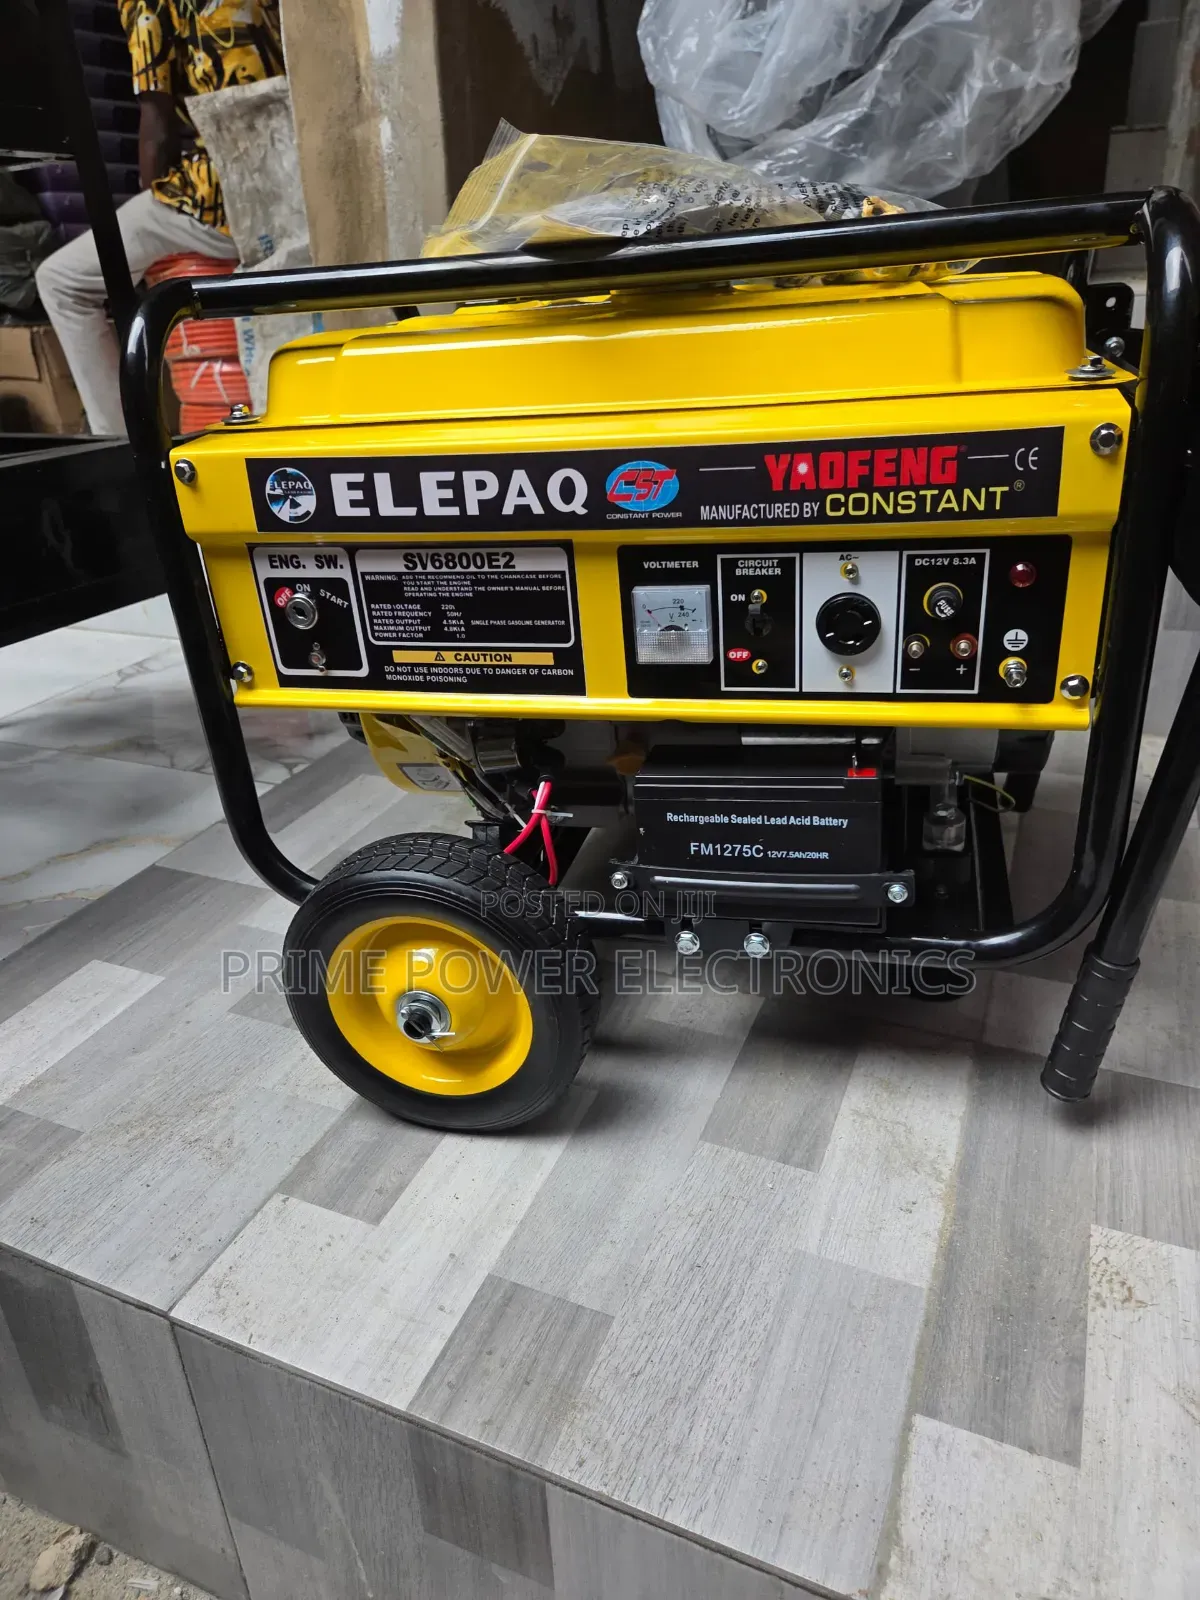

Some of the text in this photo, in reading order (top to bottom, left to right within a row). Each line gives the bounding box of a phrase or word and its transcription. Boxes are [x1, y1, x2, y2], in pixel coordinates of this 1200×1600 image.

[1014, 447, 1039, 471] CE
[764, 445, 958, 491] YAOFENG
[330, 468, 589, 517] ELEPAQ
[606, 468, 677, 503] CST
[700, 487, 1009, 520] MANUFACTURED BY CONSTANT
[268, 554, 344, 570] ENG. SW.
[402, 551, 516, 571] SV6800E2
[643, 560, 699, 569] VOLTMETER
[738, 559, 779, 567] CIRCUIT
[914, 557, 977, 566] DC12V 8.3A
[735, 568, 781, 576] BREAKER
[296, 583, 311, 592] ON
[319, 589, 349, 609] START
[730, 593, 746, 602] ON
[937, 600, 954, 616] FUSE
[454, 653, 513, 663] CAUTION
[386, 674, 468, 683] MONOXIDE POISONING
[666, 813, 848, 828] Rechargeable Sealed Lead Acid Battery
[690, 842, 764, 858] FM1275C
